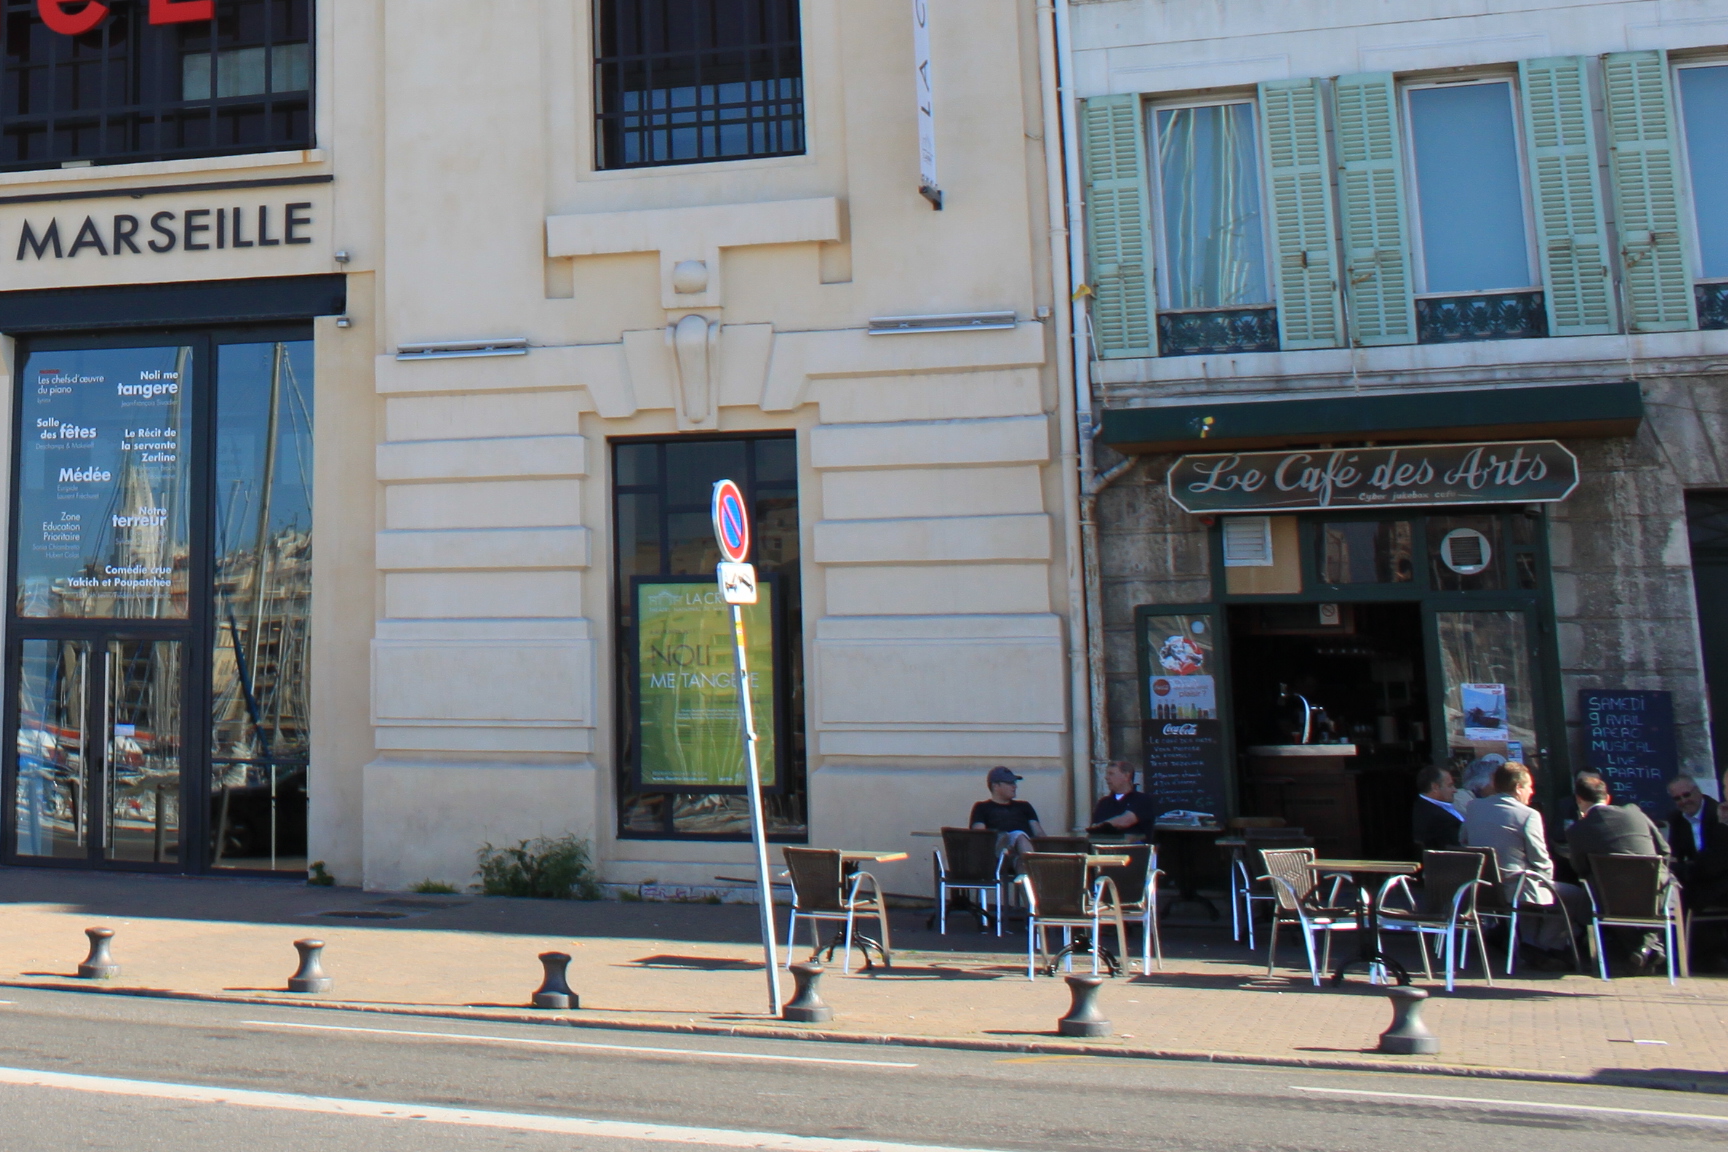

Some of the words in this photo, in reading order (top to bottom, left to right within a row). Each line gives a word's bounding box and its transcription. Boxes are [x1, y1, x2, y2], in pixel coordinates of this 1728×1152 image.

[918, 58, 932, 118] LA
[16, 201, 312, 261] MARSEILLE
[37, 376, 50, 385] Les
[140, 370, 161, 380] Noli
[163, 371, 179, 379] me
[37, 385, 48, 394] du
[49, 385, 72, 396] piano
[117, 382, 179, 399] tangere
[37, 417, 60, 427] Salle
[40, 429, 57, 439] des
[59, 423, 97, 439] fêtes
[125, 428, 136, 438] Le
[138, 428, 161, 437] Récit
[163, 427, 177, 437] de
[121, 440, 131, 450] la
[133, 440, 177, 450] servante
[141, 452, 176, 462] Zerline
[58, 466, 111, 482] Médée
[1188, 454, 1267, 492] Le
[1275, 450, 1362, 507] Café
[1368, 450, 1435, 490] des
[1444, 446, 1548, 490] Arts
[1358, 492, 1387, 502] Cyber
[1392, 491, 1430, 502] jukebox
[60, 512, 81, 521] Zone
[138, 507, 167, 516] Notre
[112, 514, 167, 527] terreur
[42, 522, 81, 531] Education
[43, 532, 81, 541] Prioritaire
[105, 565, 148, 575] Comédie
[150, 565, 172, 574] crue
[67, 577, 99, 587] Yakich
[101, 577, 112, 587] et
[114, 577, 172, 589] Poupatchée
[685, 593, 702, 605] LA
[651, 644, 710, 666] NOLI
[650, 673, 676, 689] ME
[681, 672, 759, 689] TANGEE
[1588, 712, 1601, 726] 9
[1606, 714, 1644, 726] AVRIL
[1607, 753, 1637, 765] LIVE
[1613, 782, 1636, 792] DE
